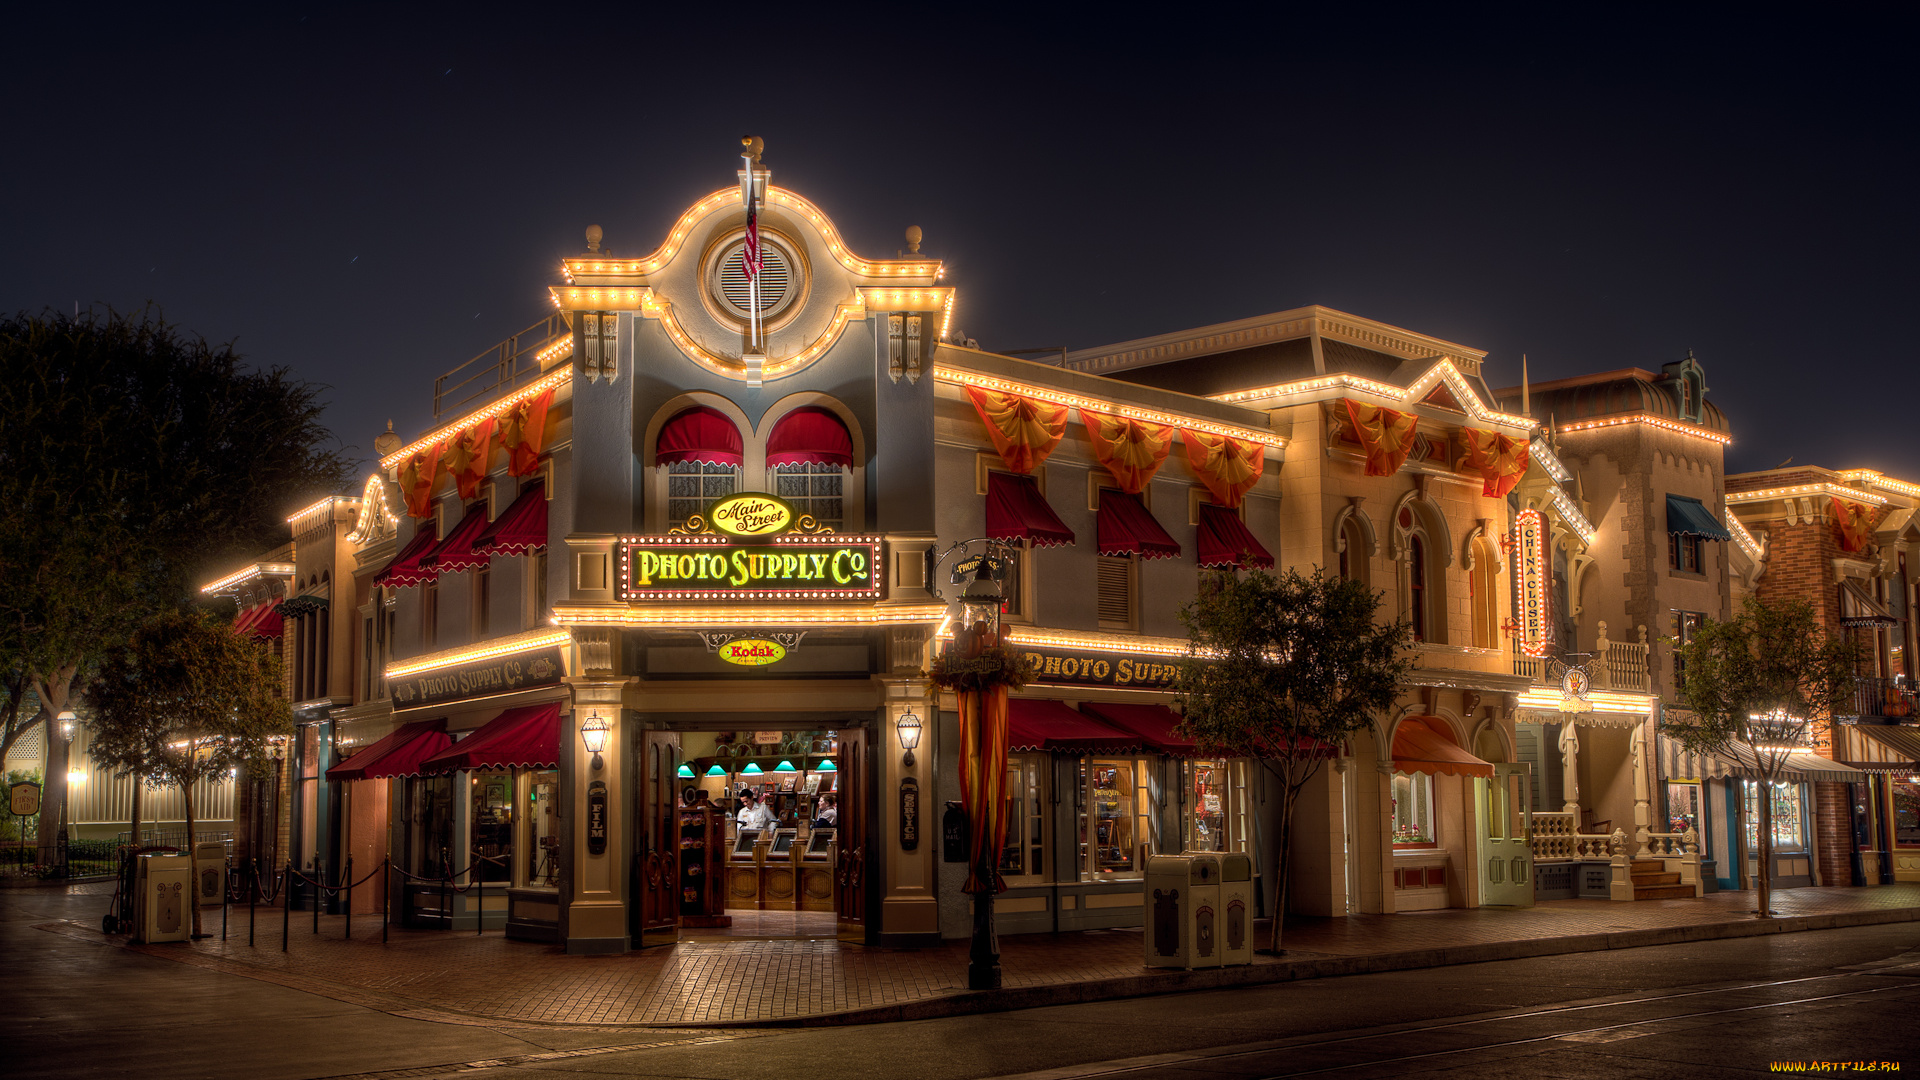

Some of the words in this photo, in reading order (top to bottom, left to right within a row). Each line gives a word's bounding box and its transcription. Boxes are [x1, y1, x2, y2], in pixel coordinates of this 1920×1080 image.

[718, 500, 775, 520] Main
[736, 510, 784, 532] Street
[958, 560, 997, 573] PHOTOSS
[1525, 529, 1536, 575] CHINA
[638, 550, 727, 585] PHOTO
[730, 550, 829, 587] SUPPLY
[1527, 580, 1538, 637] CLOSET
[731, 646, 774, 657] Kodak
[1025, 652, 1110, 679] PHOTO
[1115, 659, 1183, 683] SUPP
[418, 677, 458, 699] PHOTO
[459, 668, 503, 694] SUPPLY
[15, 796, 34, 805] FIRST
[591, 804, 604, 838] FILM
[904, 793, 915, 840] SERVICE
